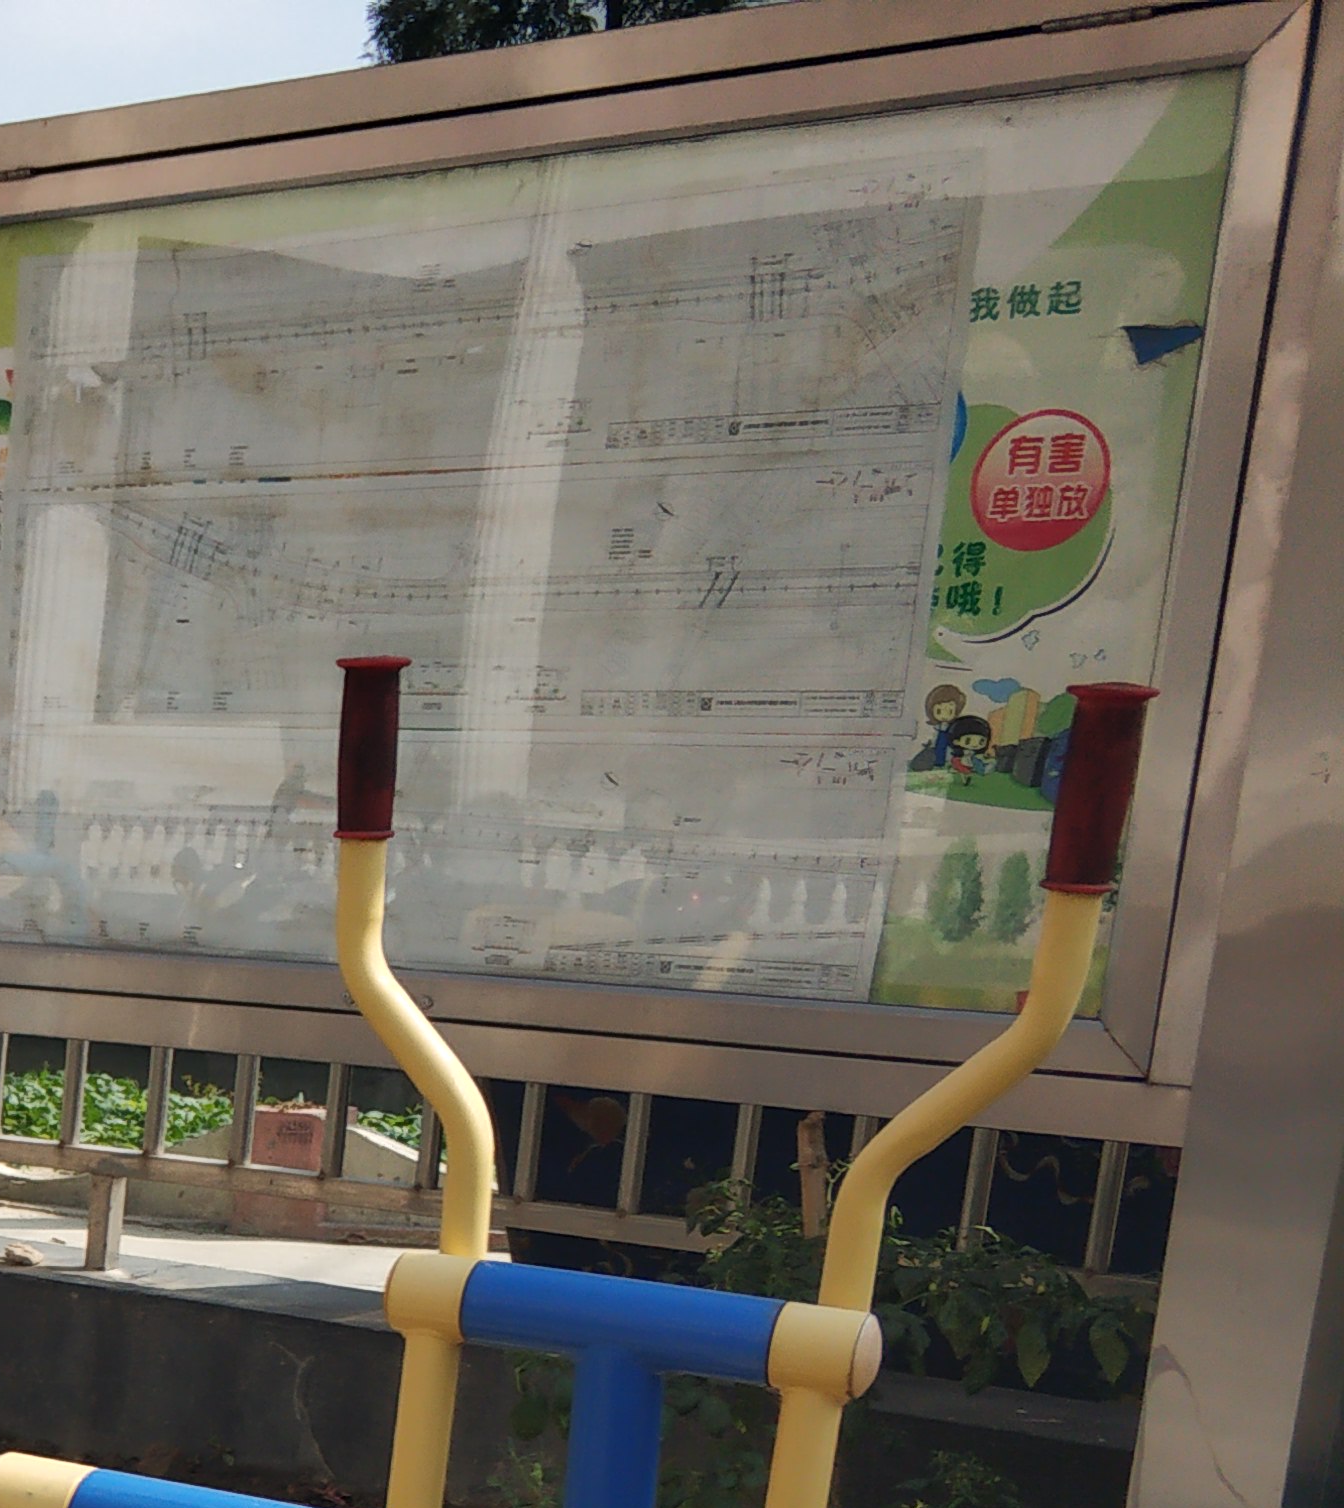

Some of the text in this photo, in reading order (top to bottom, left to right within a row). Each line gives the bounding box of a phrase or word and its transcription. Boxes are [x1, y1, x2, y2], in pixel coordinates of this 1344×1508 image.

[970, 281, 1082, 322] 我做起
[1007, 432, 1087, 476] 有害
[987, 485, 1090, 522] 单独放
